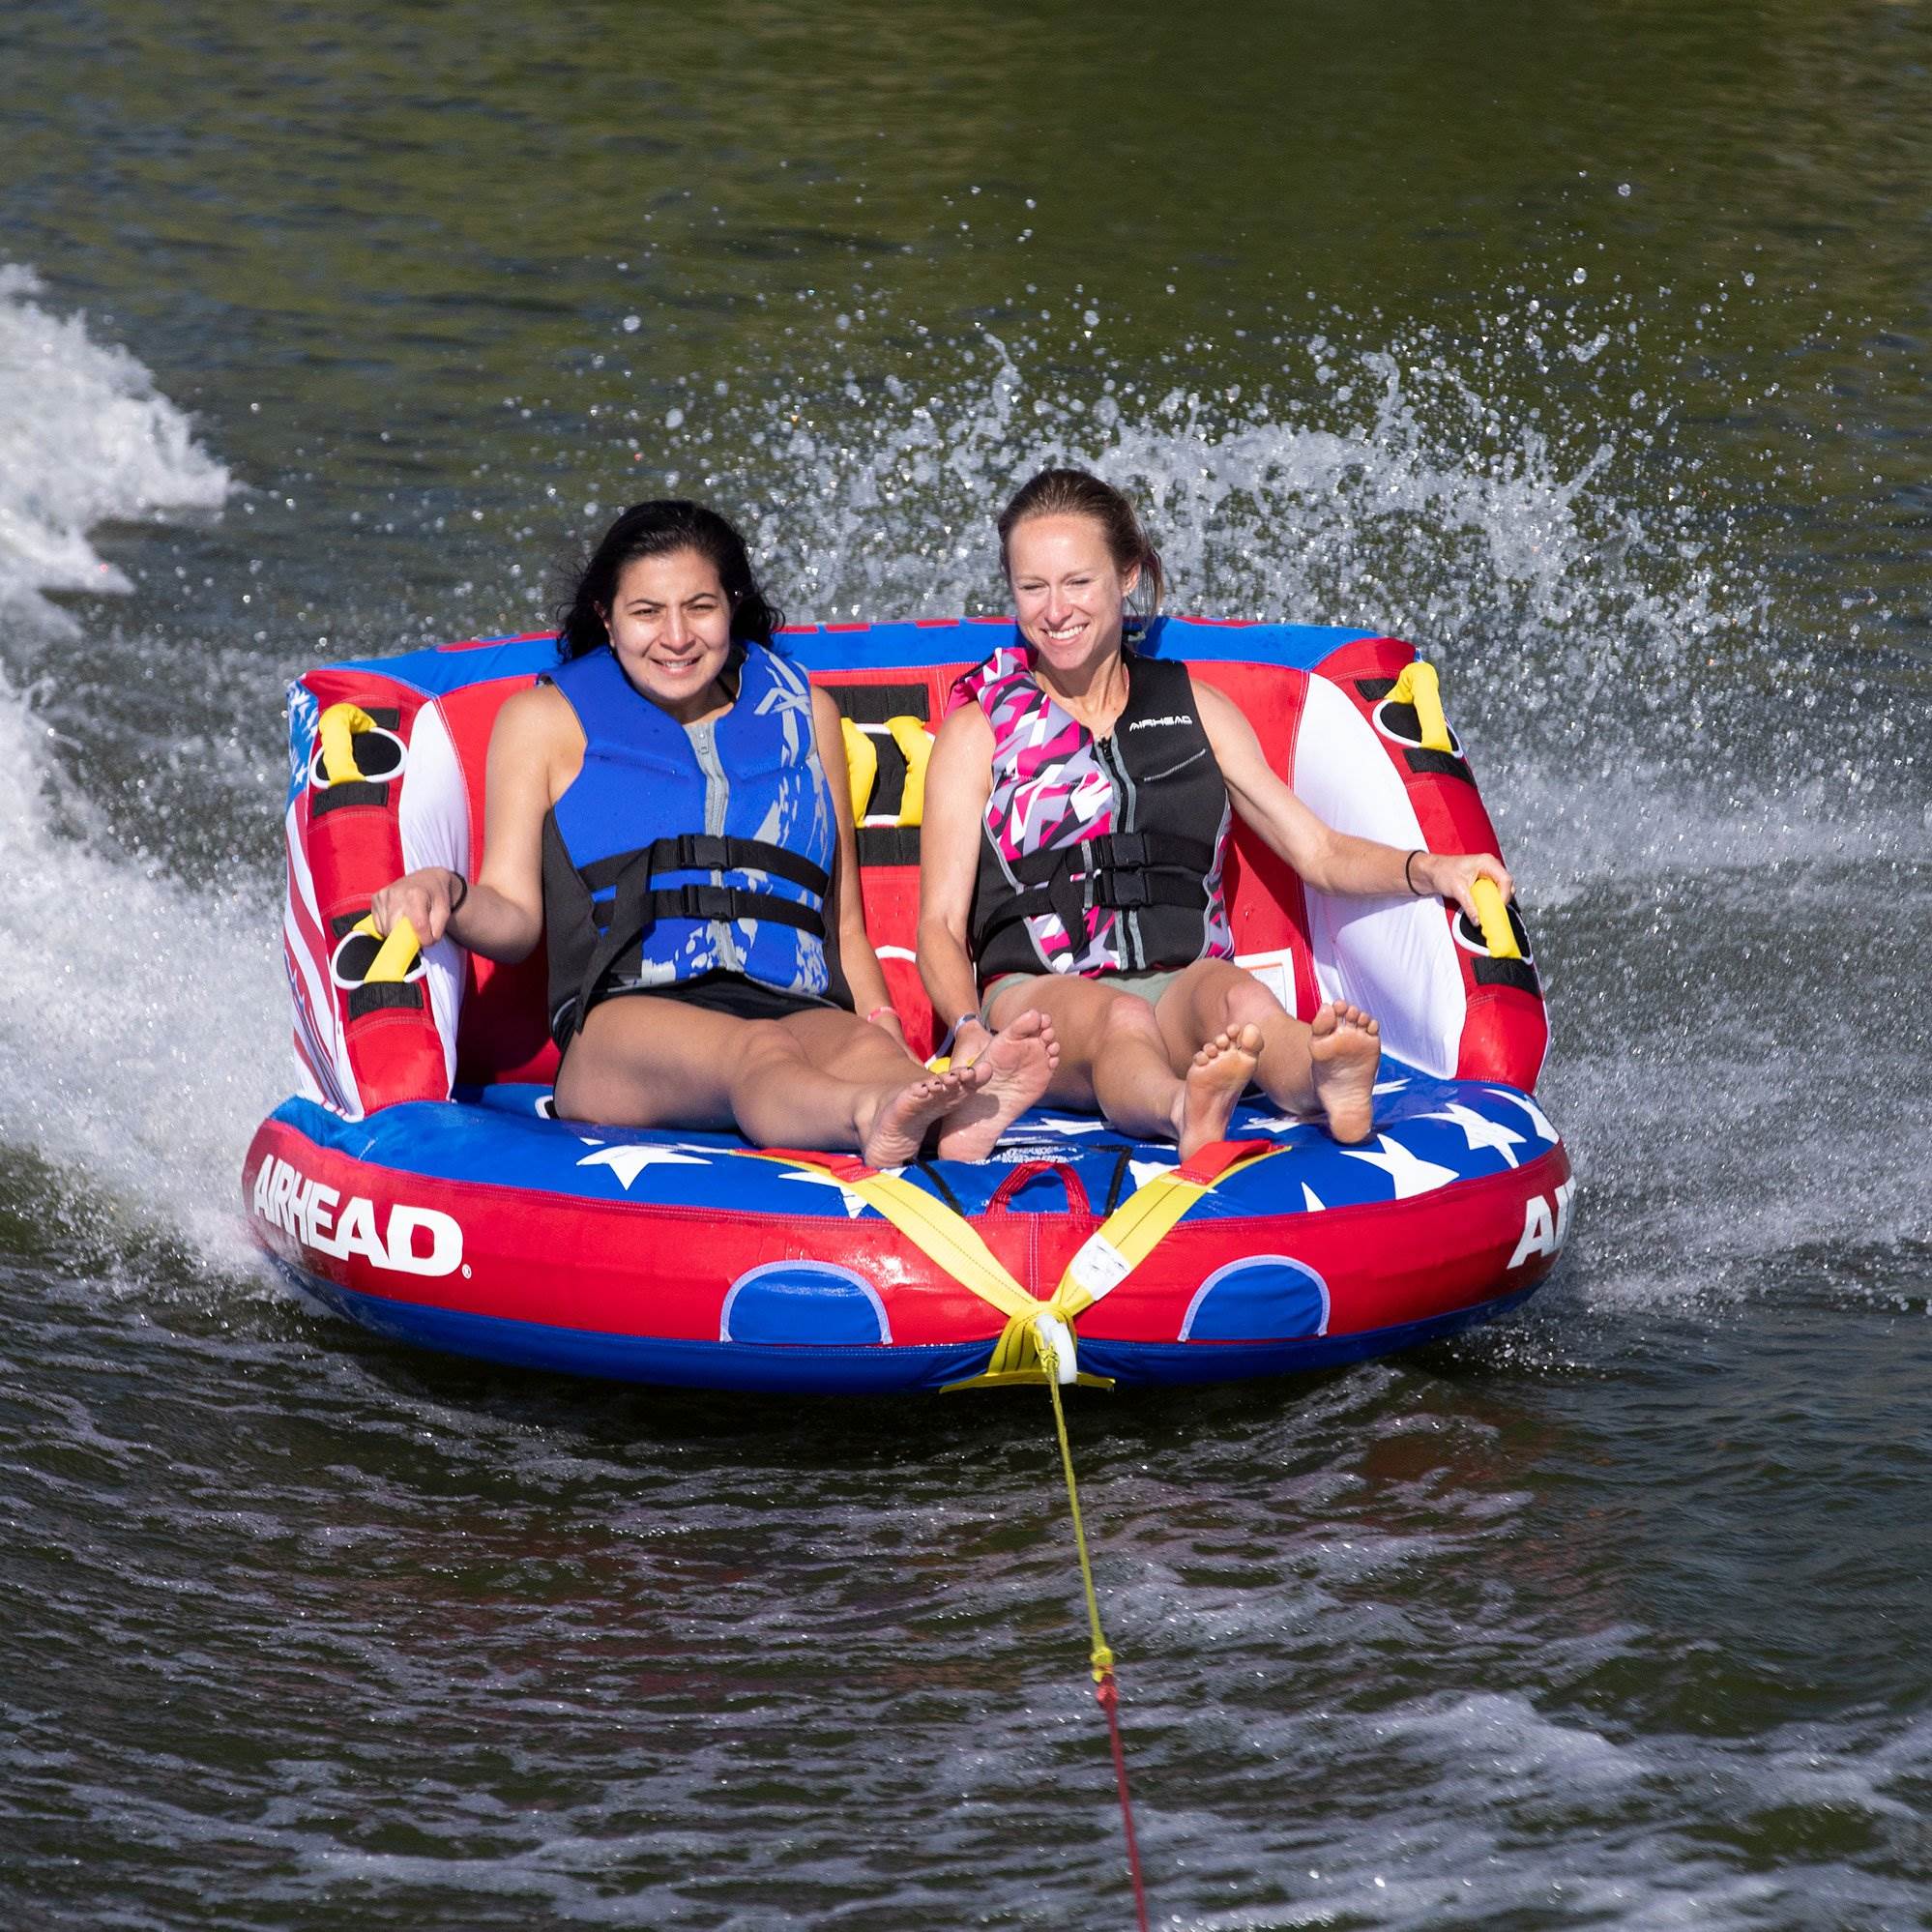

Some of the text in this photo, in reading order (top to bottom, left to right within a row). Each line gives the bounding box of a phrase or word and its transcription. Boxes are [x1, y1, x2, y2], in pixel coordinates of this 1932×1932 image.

[1129, 716, 1193, 732] AIRHEAD
[253, 1154, 464, 1276] AIRHEAD
[1506, 1175, 1577, 1270] AI
